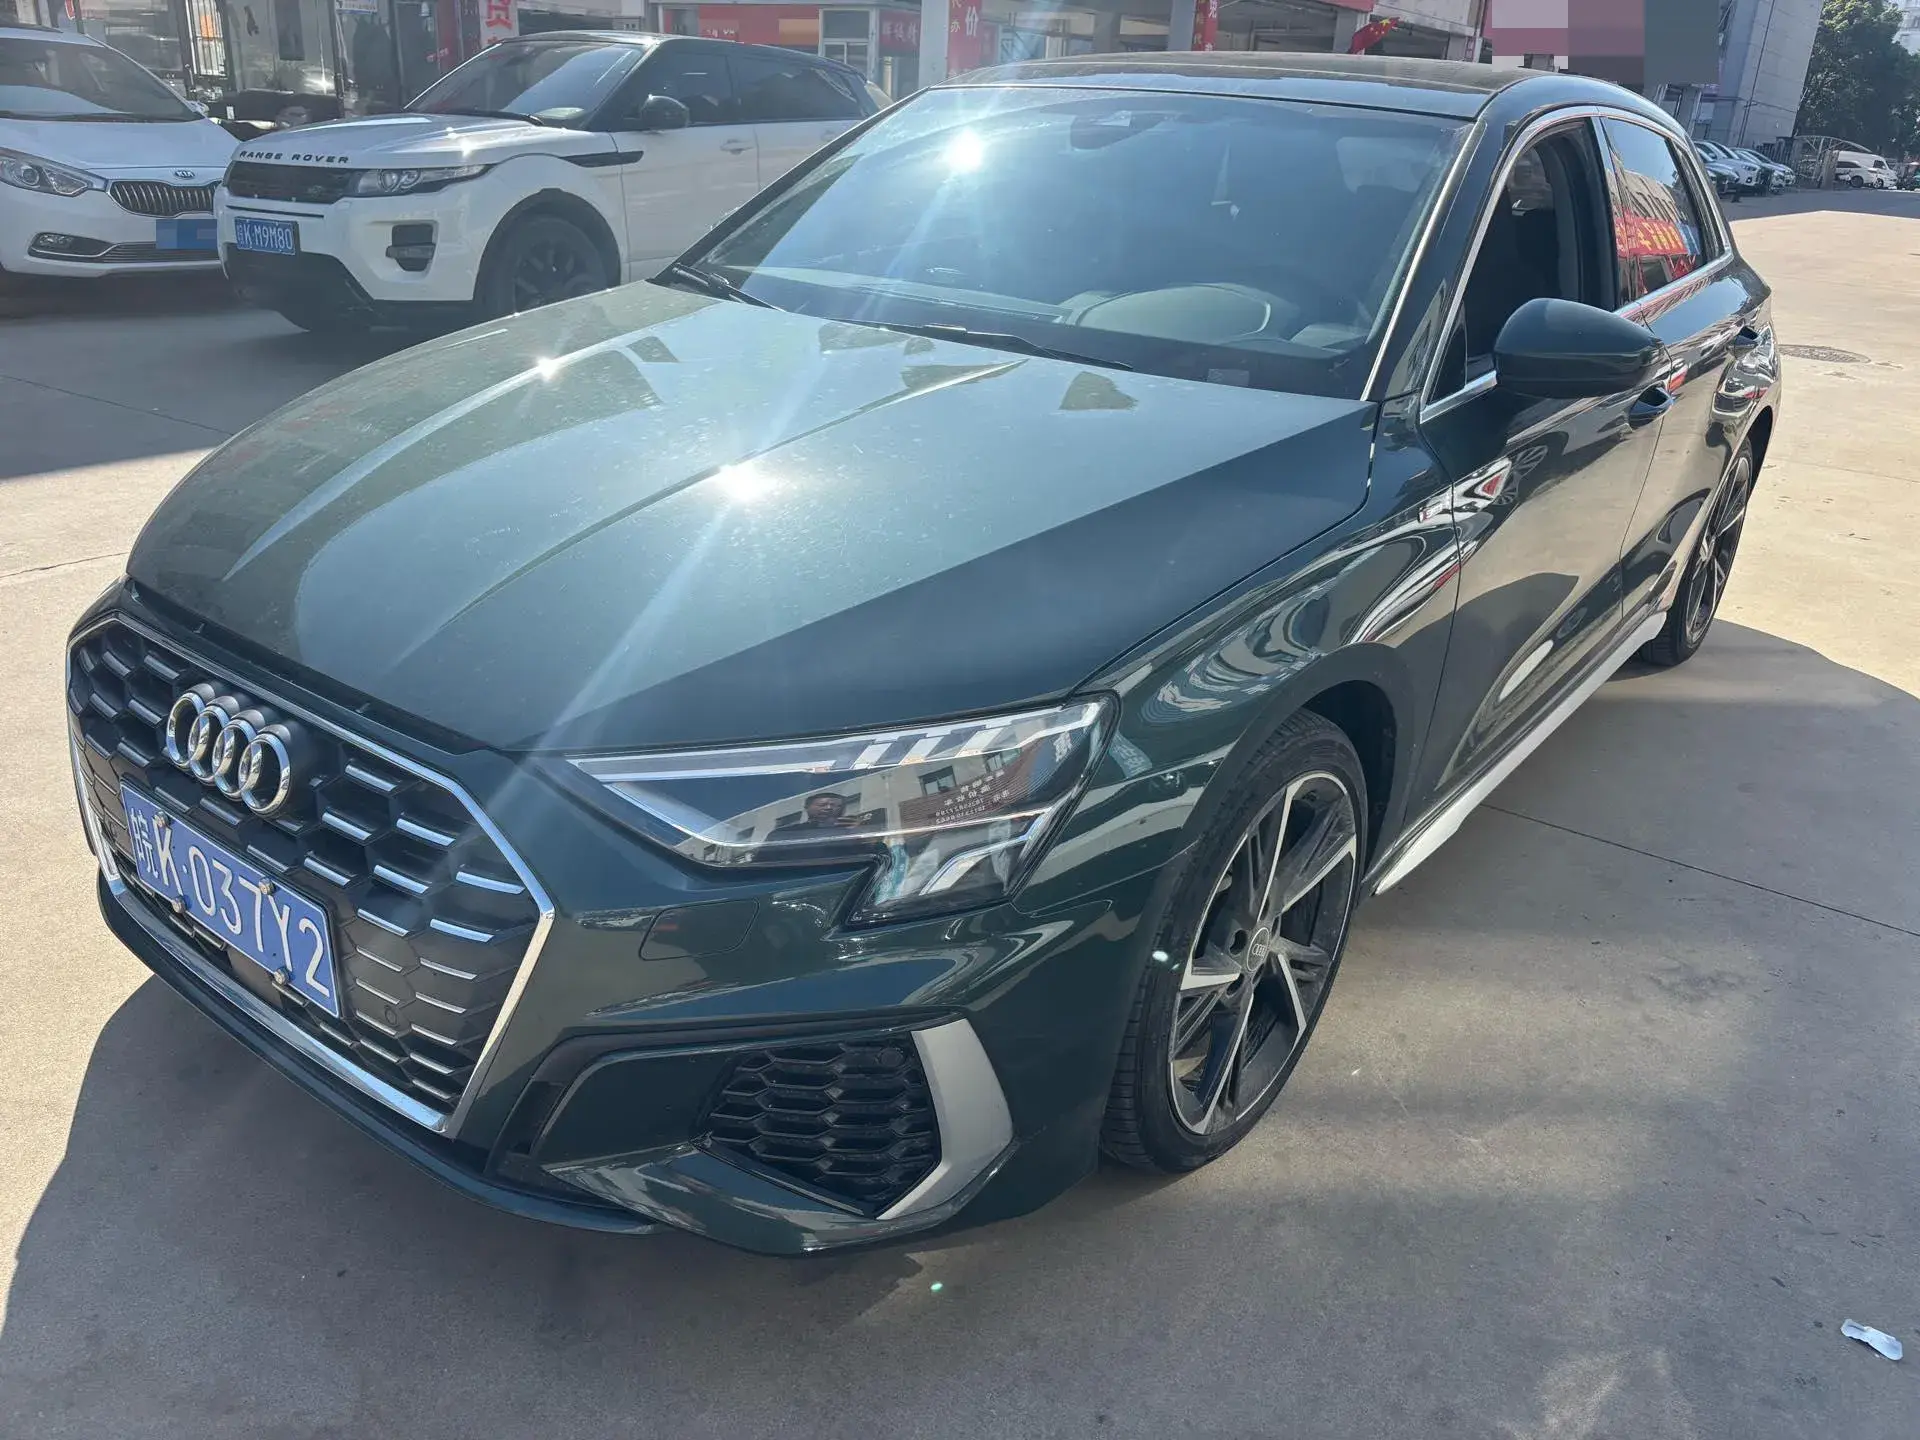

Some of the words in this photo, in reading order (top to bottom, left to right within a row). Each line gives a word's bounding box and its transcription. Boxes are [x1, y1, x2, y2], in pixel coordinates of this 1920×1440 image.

[965, 6, 979, 36] 价
[239, 150, 283, 161] RANGE
[291, 153, 349, 164] ROVER
[175, 170, 195, 178] KIA
